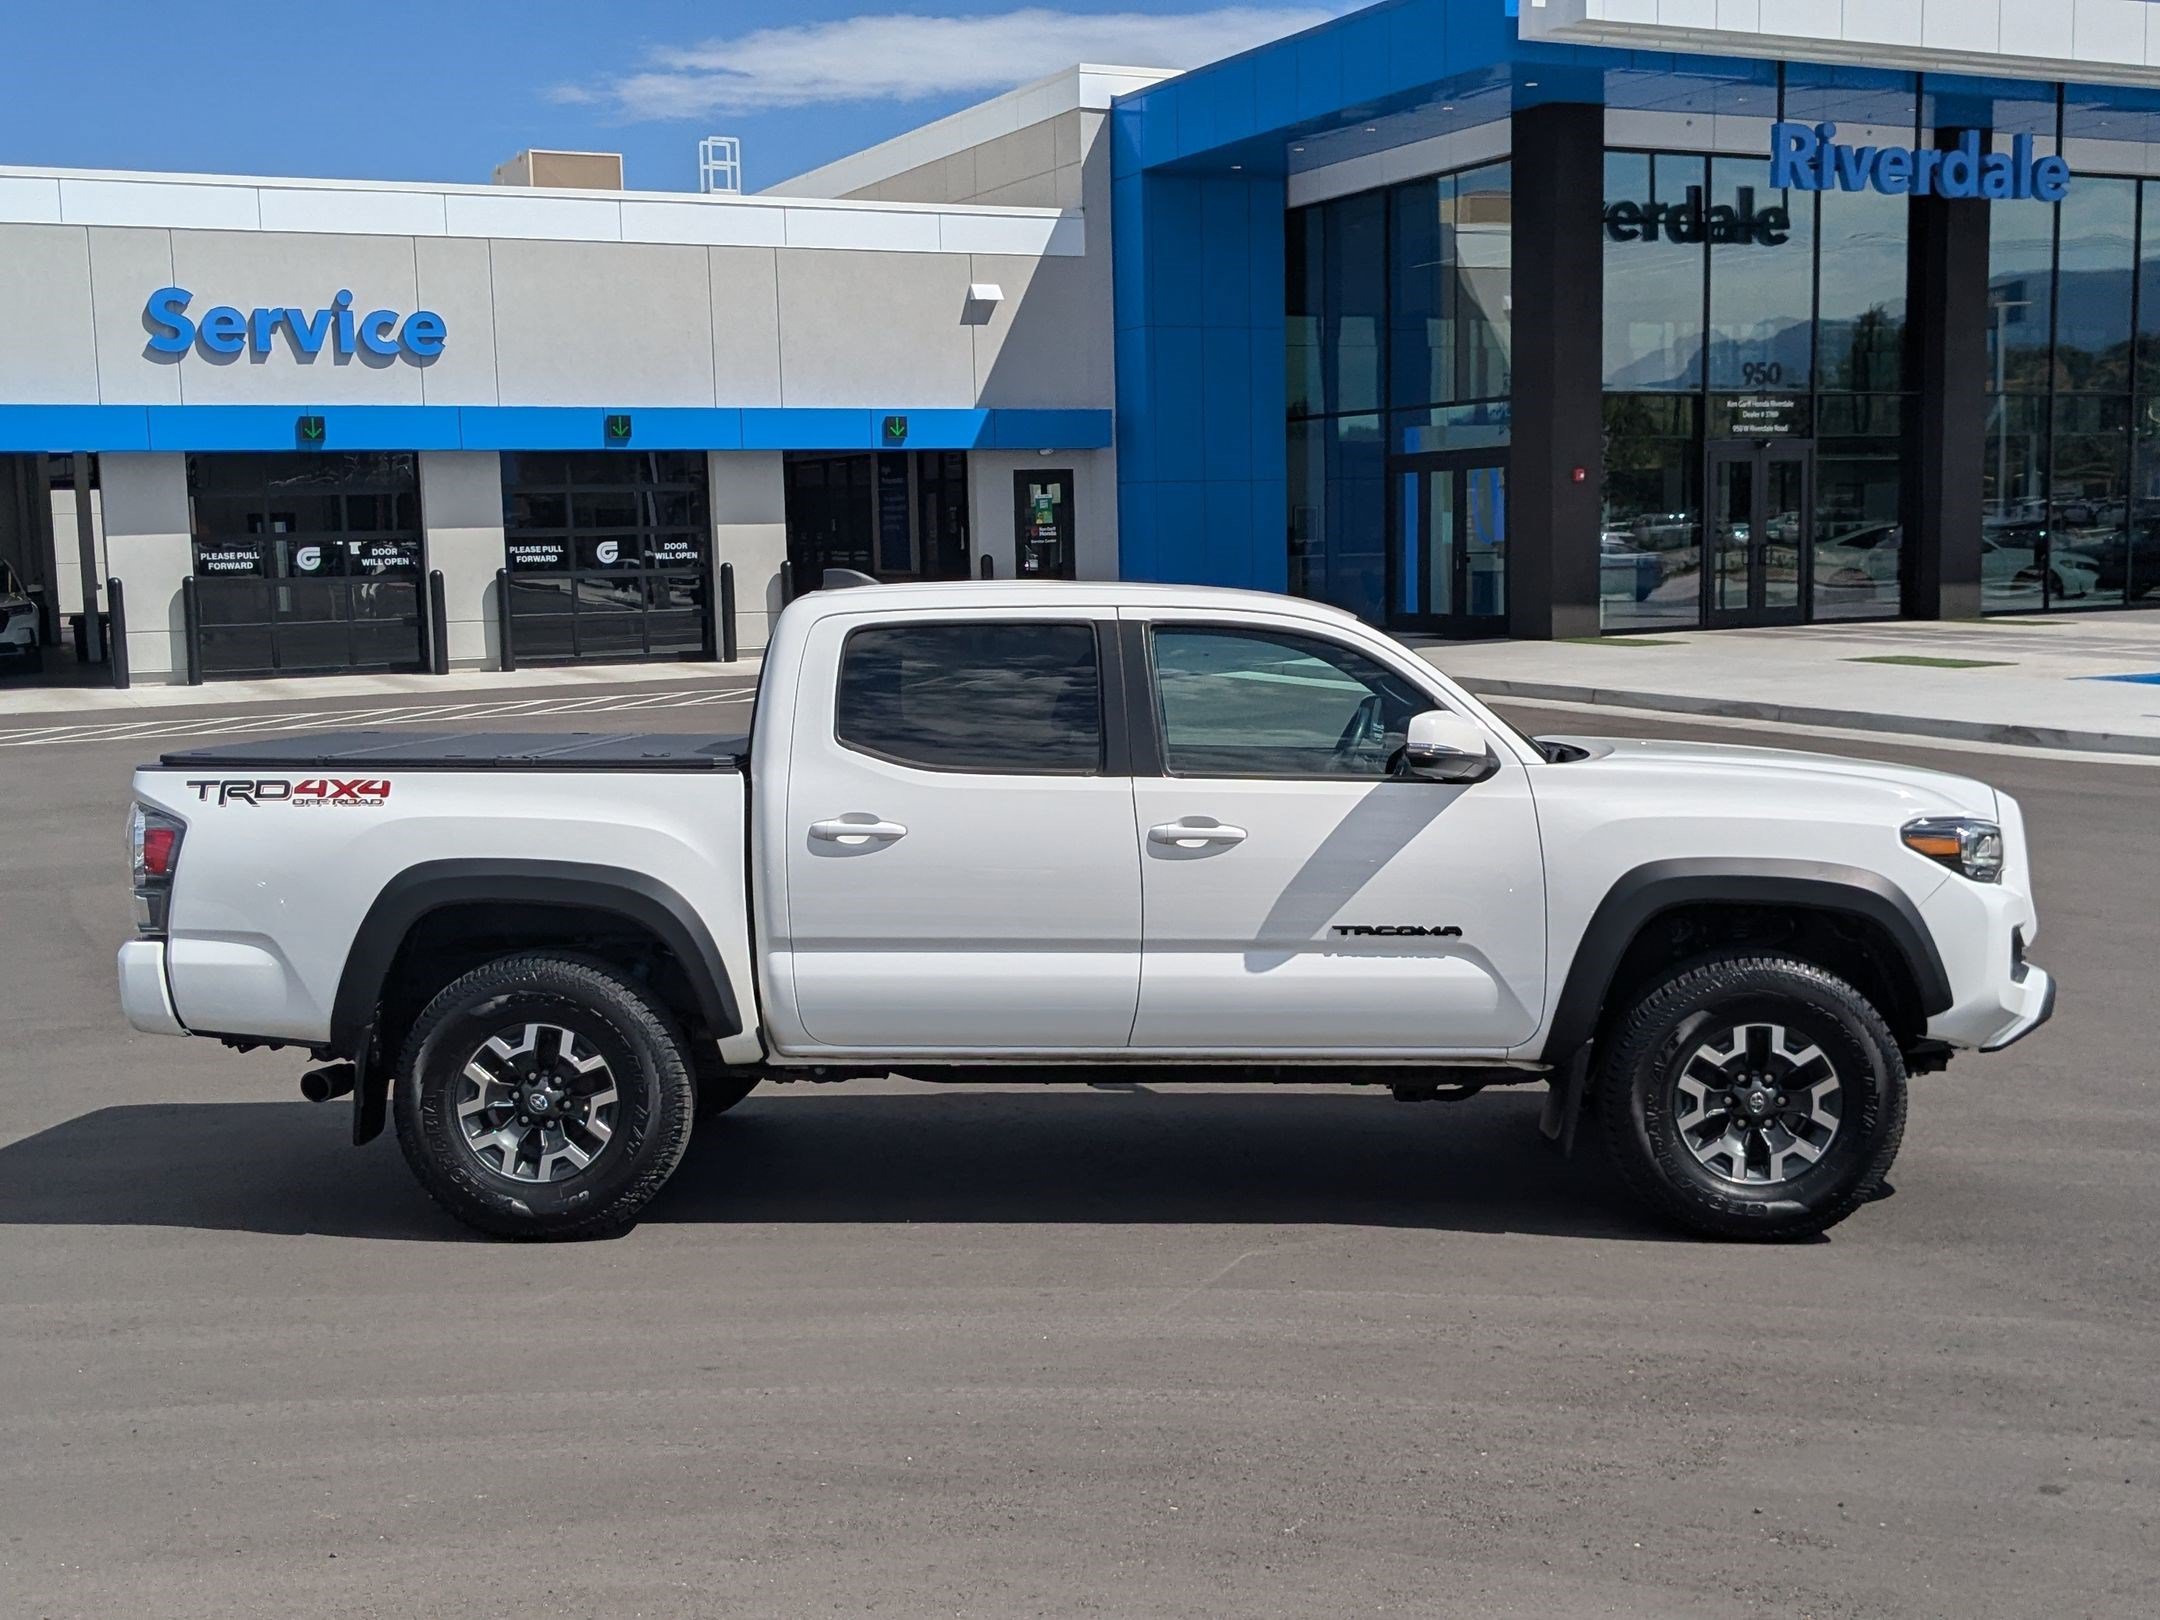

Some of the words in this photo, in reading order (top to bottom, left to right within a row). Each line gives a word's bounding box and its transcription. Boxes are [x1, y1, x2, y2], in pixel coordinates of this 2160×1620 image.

[1769, 120, 2070, 202] Riverdale
[1603, 185, 1790, 246] erdale
[147, 287, 447, 357] Service
[1743, 362, 1782, 385] 950
[509, 545, 541, 554] PLEASE
[542, 545, 564, 553] PULL
[664, 542, 688, 550] DOOR
[200, 552, 236, 561] PLEASE
[236, 551, 260, 560] PULL
[372, 547, 398, 556] DOOR
[655, 552, 675, 560] WILL
[676, 551, 698, 559] OPEN
[361, 557, 383, 566] WILL
[384, 557, 409, 566] OPEN
[516, 555, 558, 563] FORWARD
[208, 561, 254, 570] FORWARD
[186, 779, 294, 807] TRD
[292, 798, 331, 807] OFF
[332, 798, 385, 807] ROAD
[1331, 925, 1463, 937] TACOMA
